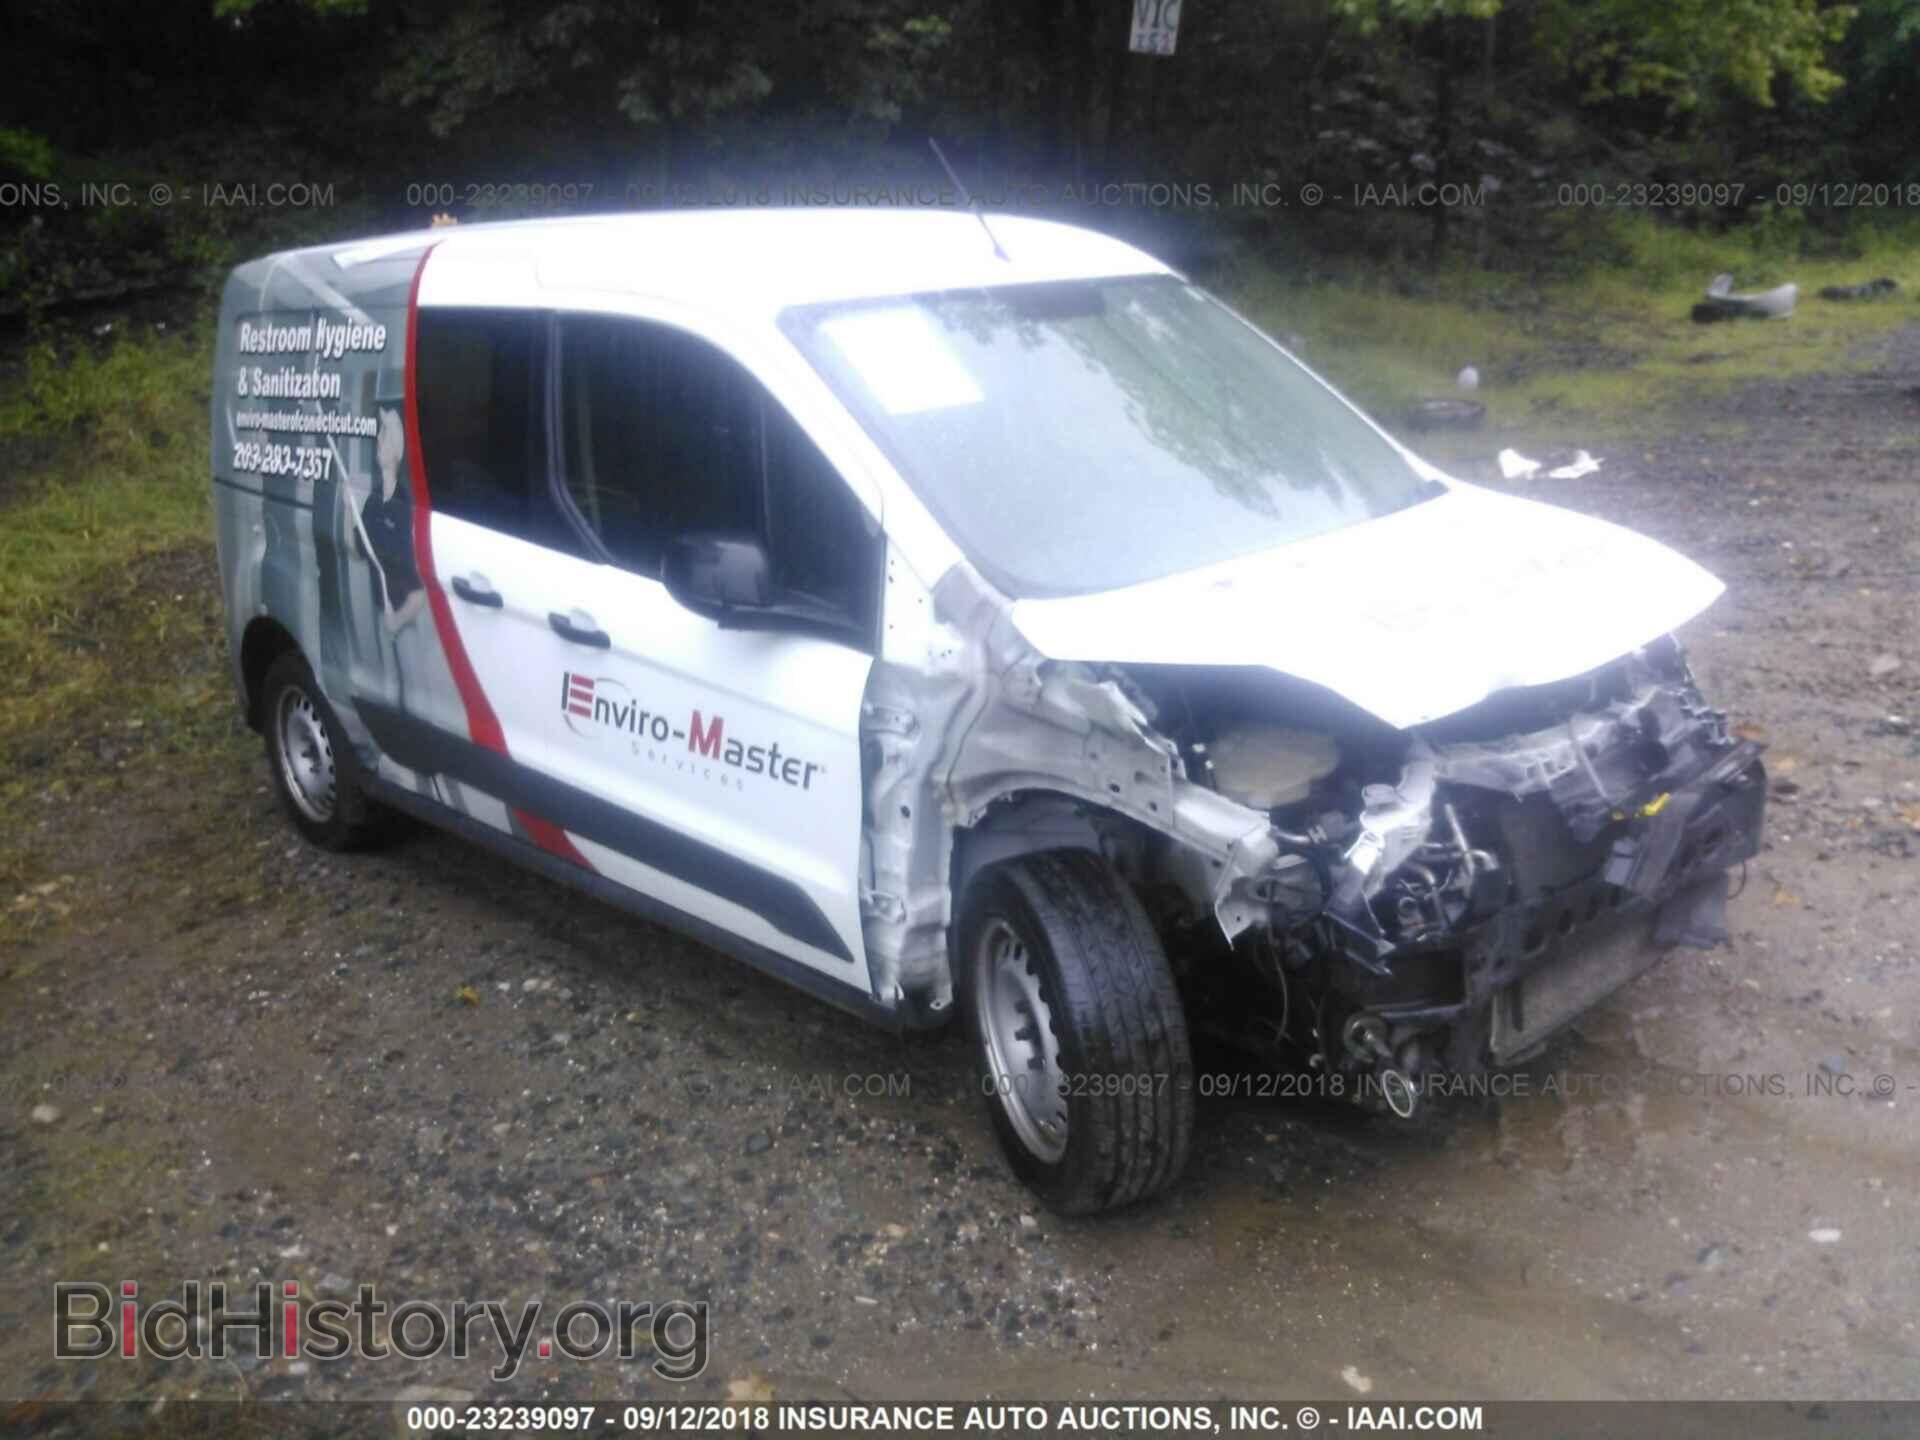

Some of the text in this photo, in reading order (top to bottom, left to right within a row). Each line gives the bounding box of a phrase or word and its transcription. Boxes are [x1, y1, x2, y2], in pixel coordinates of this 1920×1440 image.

[240, 318, 386, 358] Restroom Hygiene
[238, 365, 248, 397] &
[561, 671, 819, 791] Enviro-Master
